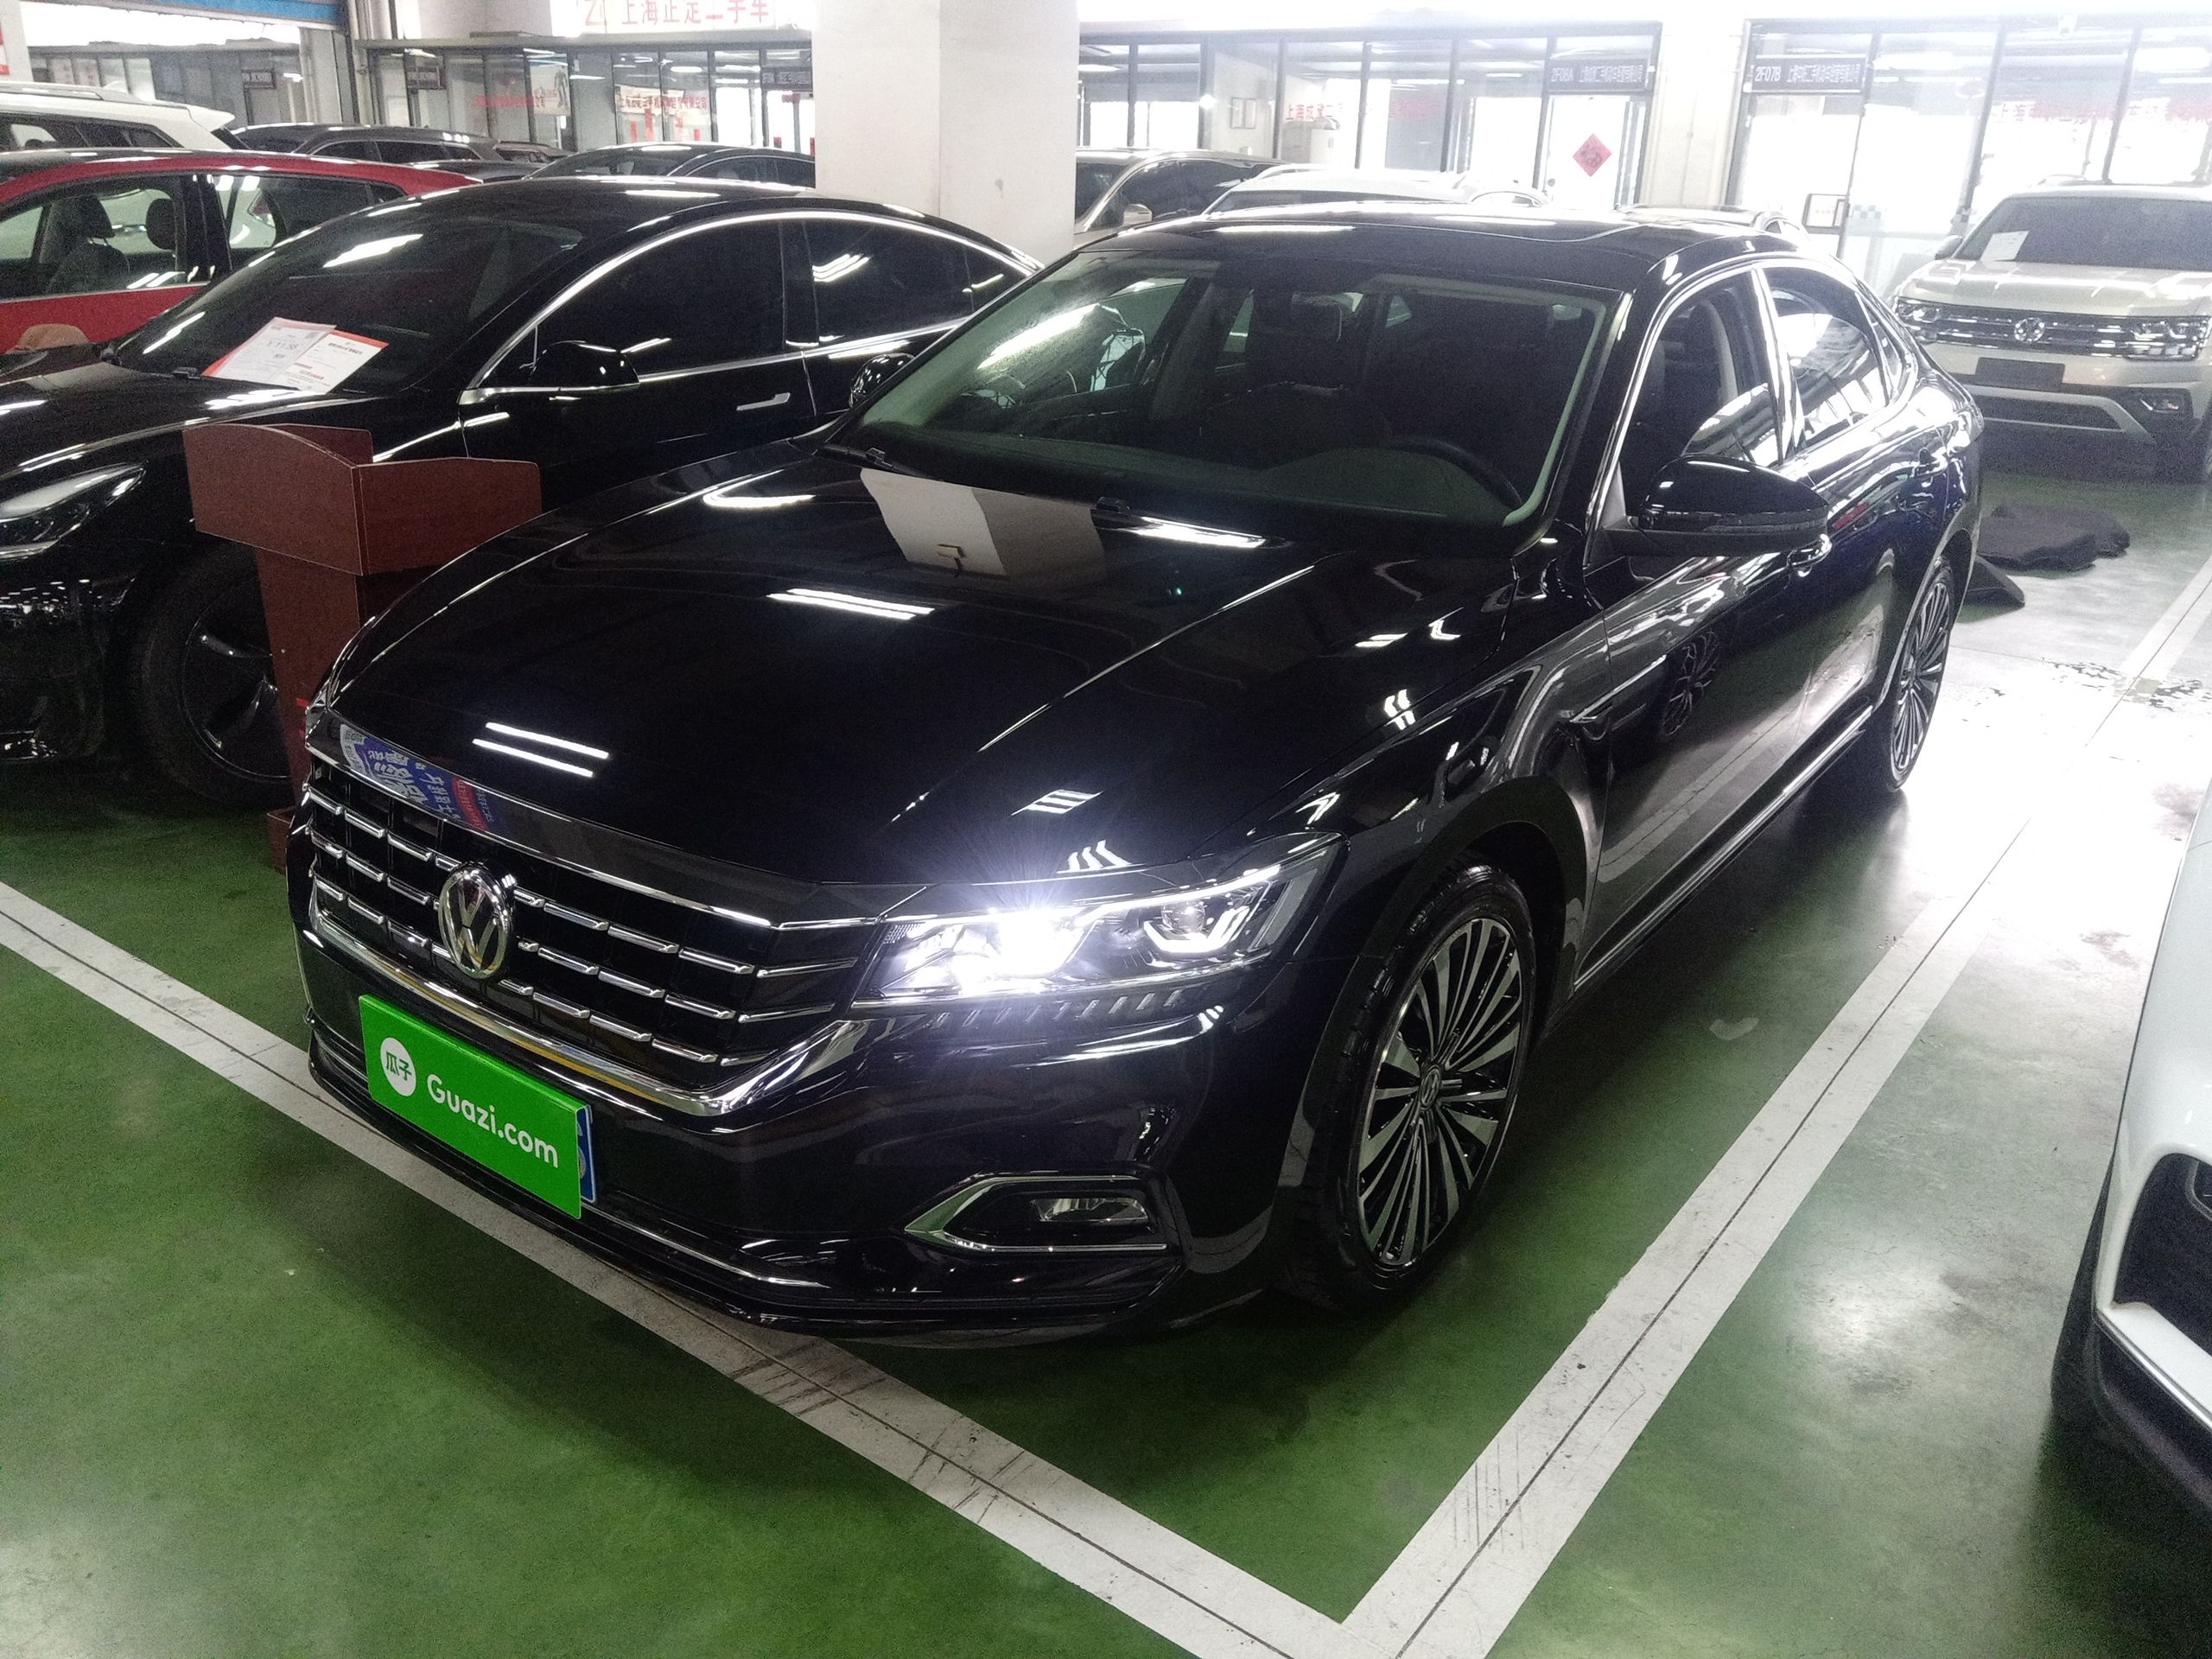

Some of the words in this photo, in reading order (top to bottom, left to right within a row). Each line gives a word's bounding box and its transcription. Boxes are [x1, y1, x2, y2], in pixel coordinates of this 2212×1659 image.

[1754, 66, 1782, 82] 2F07B
[386, 1051, 412, 1082] 瓜子
[427, 1074, 559, 1169] Guazi.com
